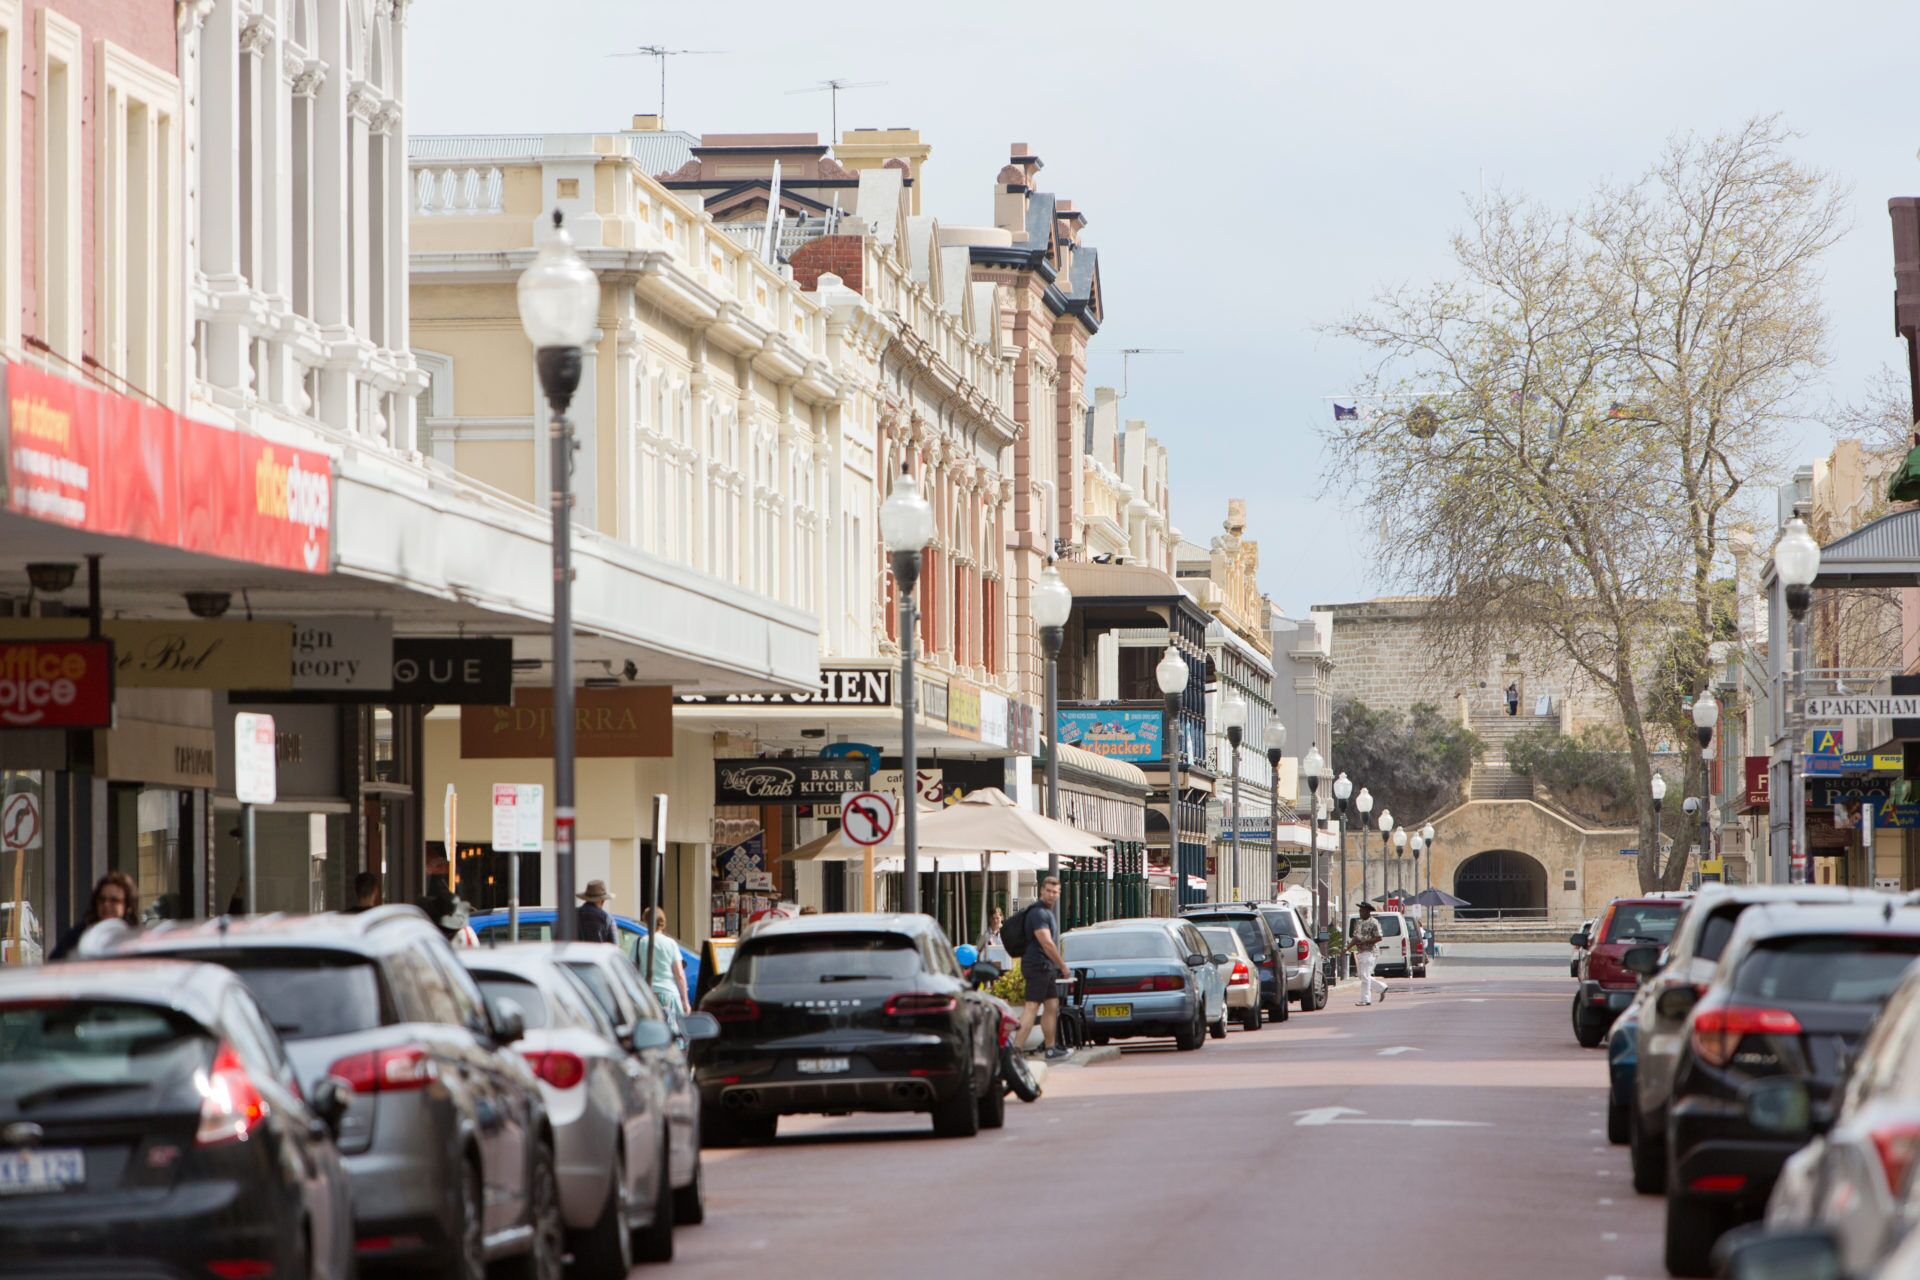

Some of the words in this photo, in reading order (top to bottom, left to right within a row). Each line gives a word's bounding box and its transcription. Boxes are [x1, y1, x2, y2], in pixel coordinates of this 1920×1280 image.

[0, 647, 86, 680] ffice
[1821, 700, 1917, 715] PAKENHAM
[514, 707, 638, 738] DJRRA
[1080, 740, 1152, 755] ackpackers
[812, 769, 838, 780] BAR
[844, 769, 853, 780] &
[887, 774, 903, 783] caf
[800, 780, 864, 792] KITCHEN
[818, 804, 841, 815] lun
[1220, 818, 1254, 827] HERY
